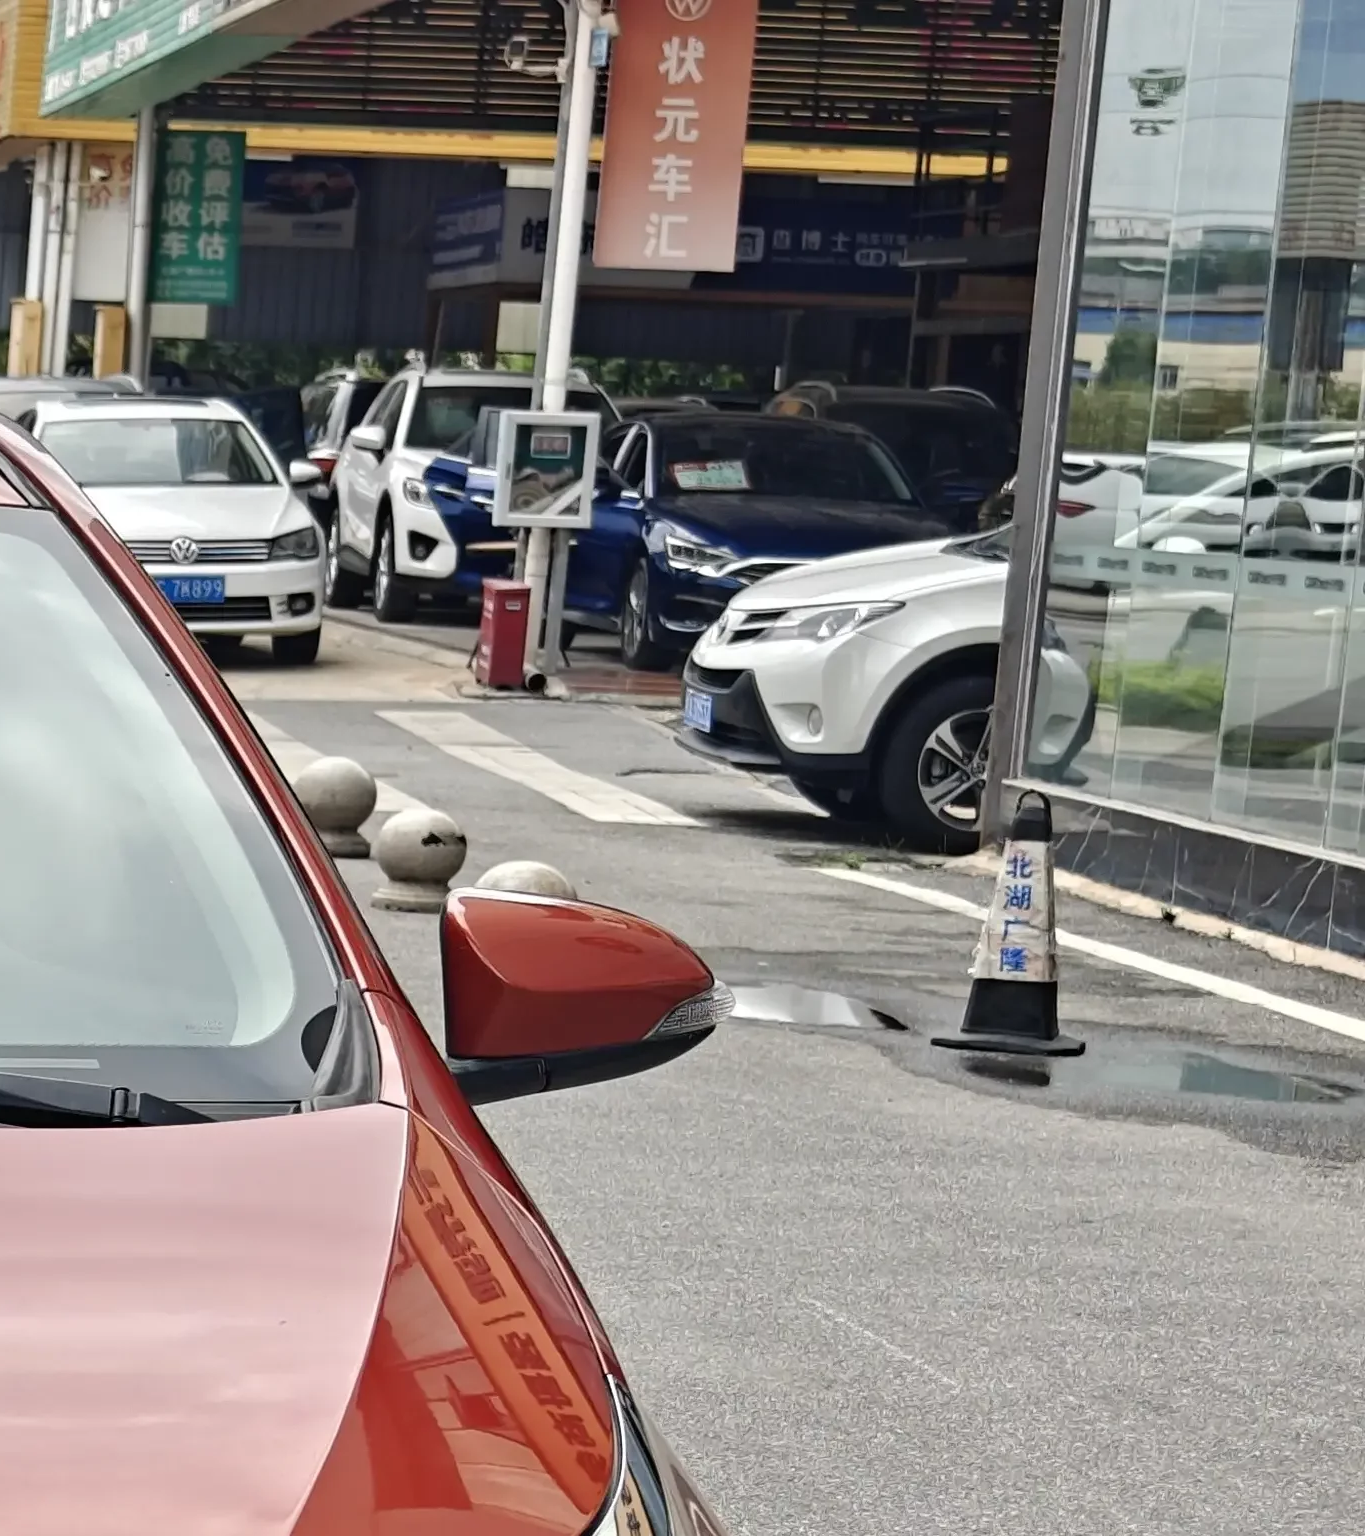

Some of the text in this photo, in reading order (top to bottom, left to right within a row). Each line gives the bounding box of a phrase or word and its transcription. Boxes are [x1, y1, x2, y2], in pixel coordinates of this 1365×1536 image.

[161, 135, 196, 260] 高价收车
[196, 136, 232, 261] 免费评估
[642, 35, 705, 259] 状元车汇
[999, 854, 1033, 972] 北湖广隆
